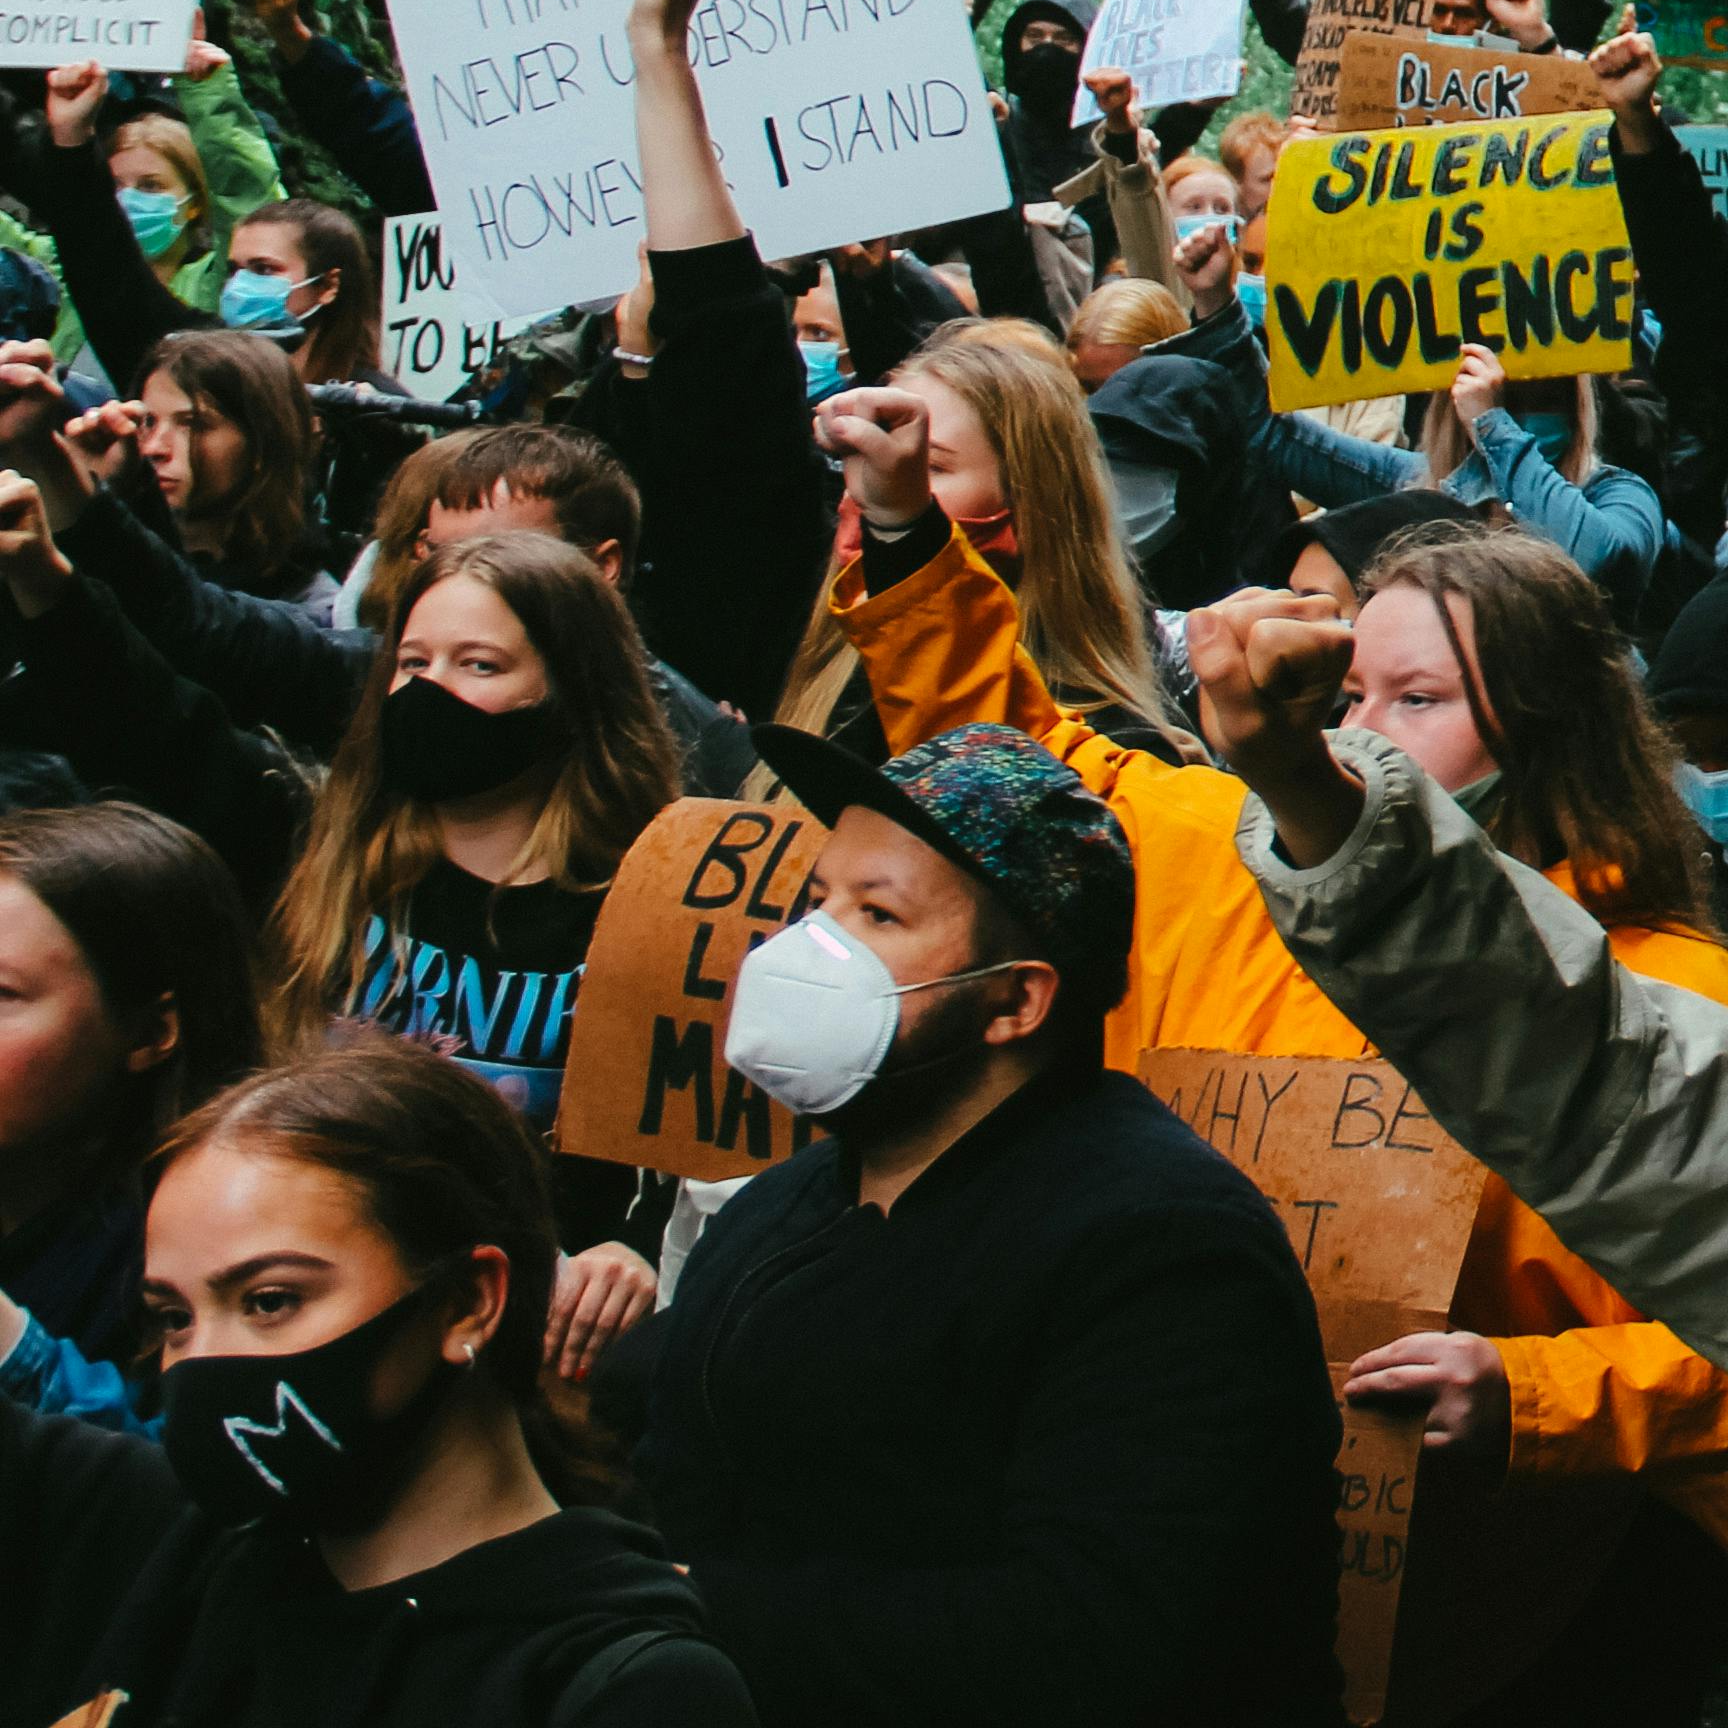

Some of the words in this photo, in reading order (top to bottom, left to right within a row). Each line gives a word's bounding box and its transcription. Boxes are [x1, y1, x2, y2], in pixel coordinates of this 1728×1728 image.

[0, 12, 161, 45] OMPLICIT
[432, 41, 586, 142] NEVER
[765, 114, 789, 189] I
[796, 78, 969, 172] STAND
[1396, 52, 1529, 119] BLACK
[1312, 120, 1616, 216] SILENCE
[1422, 201, 1485, 262] IS
[388, 316, 446, 379] TO
[1273, 246, 1635, 378] VIOLENCE
[223, 1379, 343, 1497] M
